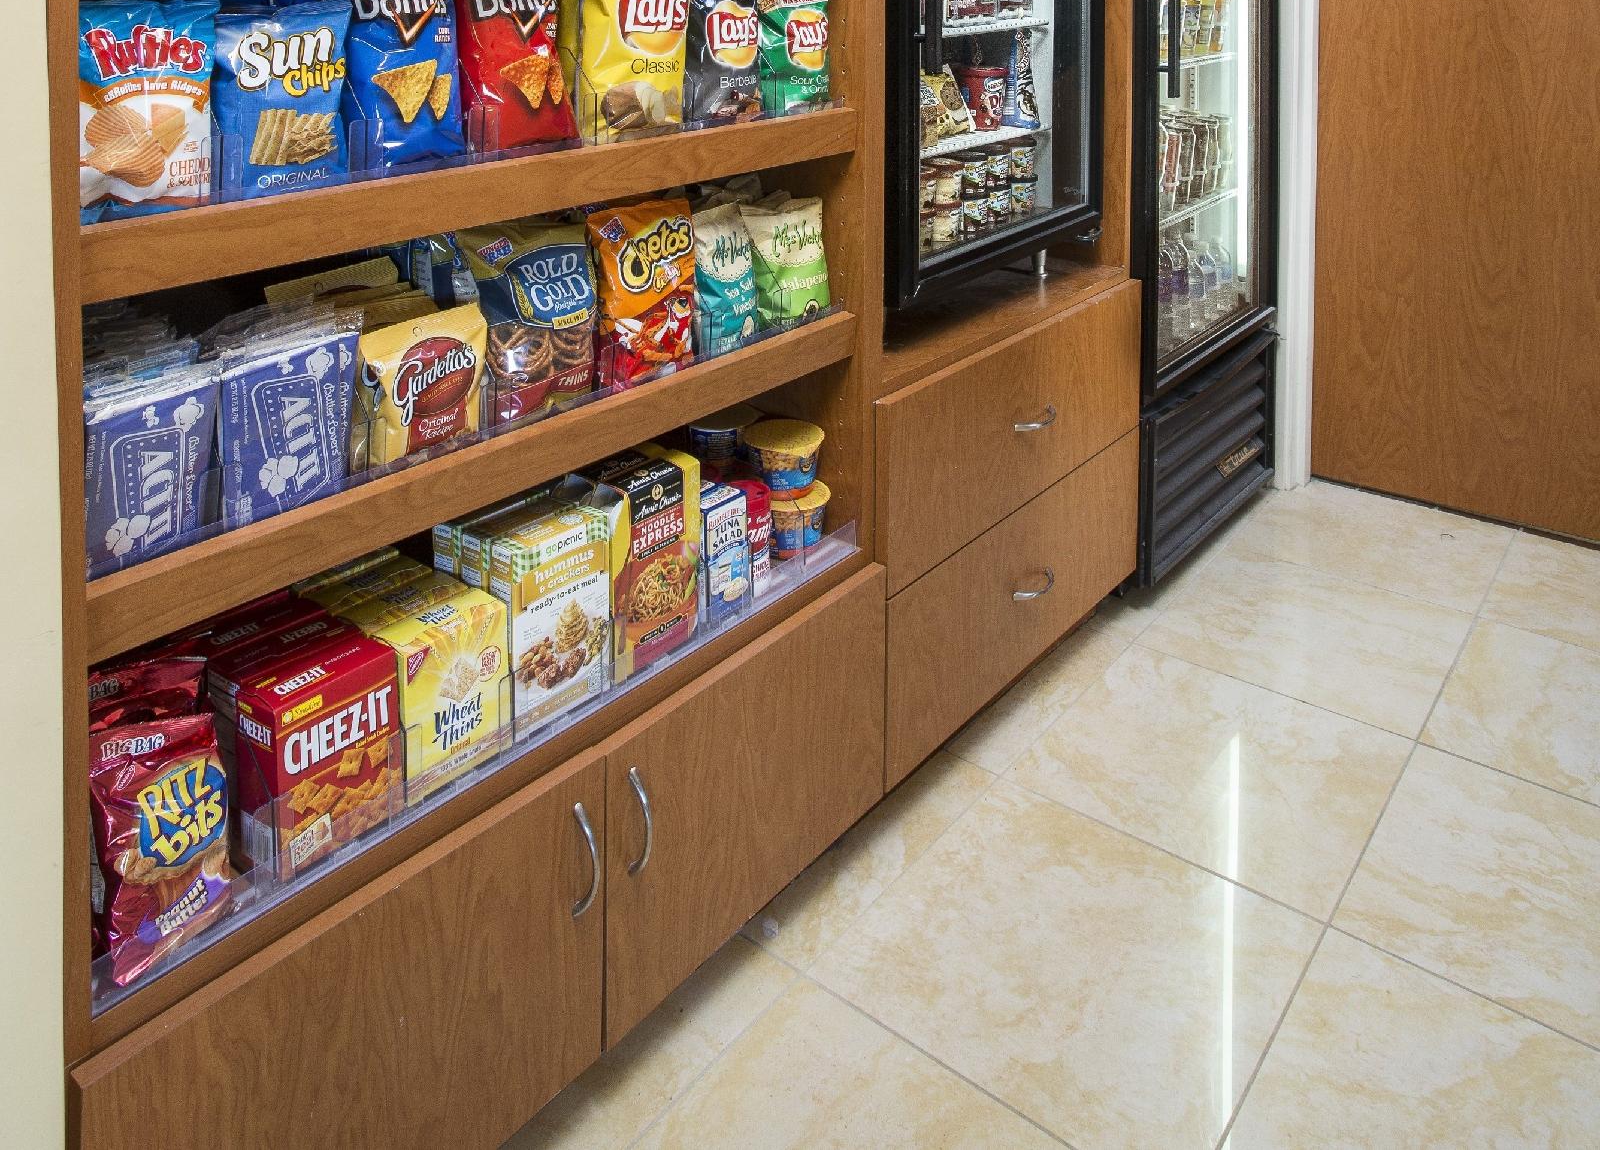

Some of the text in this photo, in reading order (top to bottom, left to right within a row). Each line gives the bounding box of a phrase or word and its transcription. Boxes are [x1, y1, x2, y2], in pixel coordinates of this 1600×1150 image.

[713, 12, 759, 50] Lay's
[789, 19, 828, 53] Lay's
[84, 24, 207, 81] Ruffles
[238, 27, 335, 91] Sun
[631, 58, 680, 75] Classic
[170, 80, 203, 96] Ridges
[283, 57, 346, 99] Chips
[720, 74, 757, 89] Barbecue
[790, 75, 814, 85] Sour
[801, 85, 808, 94] &
[167, 178, 175, 189] &
[169, 156, 211, 178] CHEDD
[257, 167, 330, 190] ORIGINAL
[519, 252, 578, 284] ROLD
[620, 220, 693, 285] Cheetos
[531, 274, 590, 311] GOLD
[725, 287, 740, 300] Sea
[393, 342, 475, 427] Gardetto's
[558, 369, 589, 387] THINS
[280, 396, 316, 453] ACT
[323, 383, 342, 456] Butter Lovers
[419, 407, 459, 432] Original
[422, 424, 454, 440] Recipe
[188, 435, 200, 472] Butter
[139, 450, 176, 513] ACT
[633, 519, 685, 553] EXPRESS
[641, 512, 675, 535] NOODLE
[713, 528, 743, 551] SALAD
[715, 519, 741, 538] TUNA
[544, 531, 584, 557] gopicnic
[534, 547, 595, 585] hummus
[547, 563, 591, 590] crackers
[530, 575, 599, 615] ready-to-eat meal
[89, 678, 120, 699] BAG
[274, 665, 327, 696] CHEEZ-IT
[239, 714, 272, 746] CHEEZ-IT
[284, 685, 392, 775] CHEEZ-IT
[434, 692, 483, 735] Wheat
[101, 733, 165, 761] BIG BAG
[432, 711, 483, 751] Thins
[137, 757, 213, 838] RITZ
[151, 789, 223, 866] bits
[154, 878, 205, 927] Peanut
[159, 891, 210, 935] Butter
